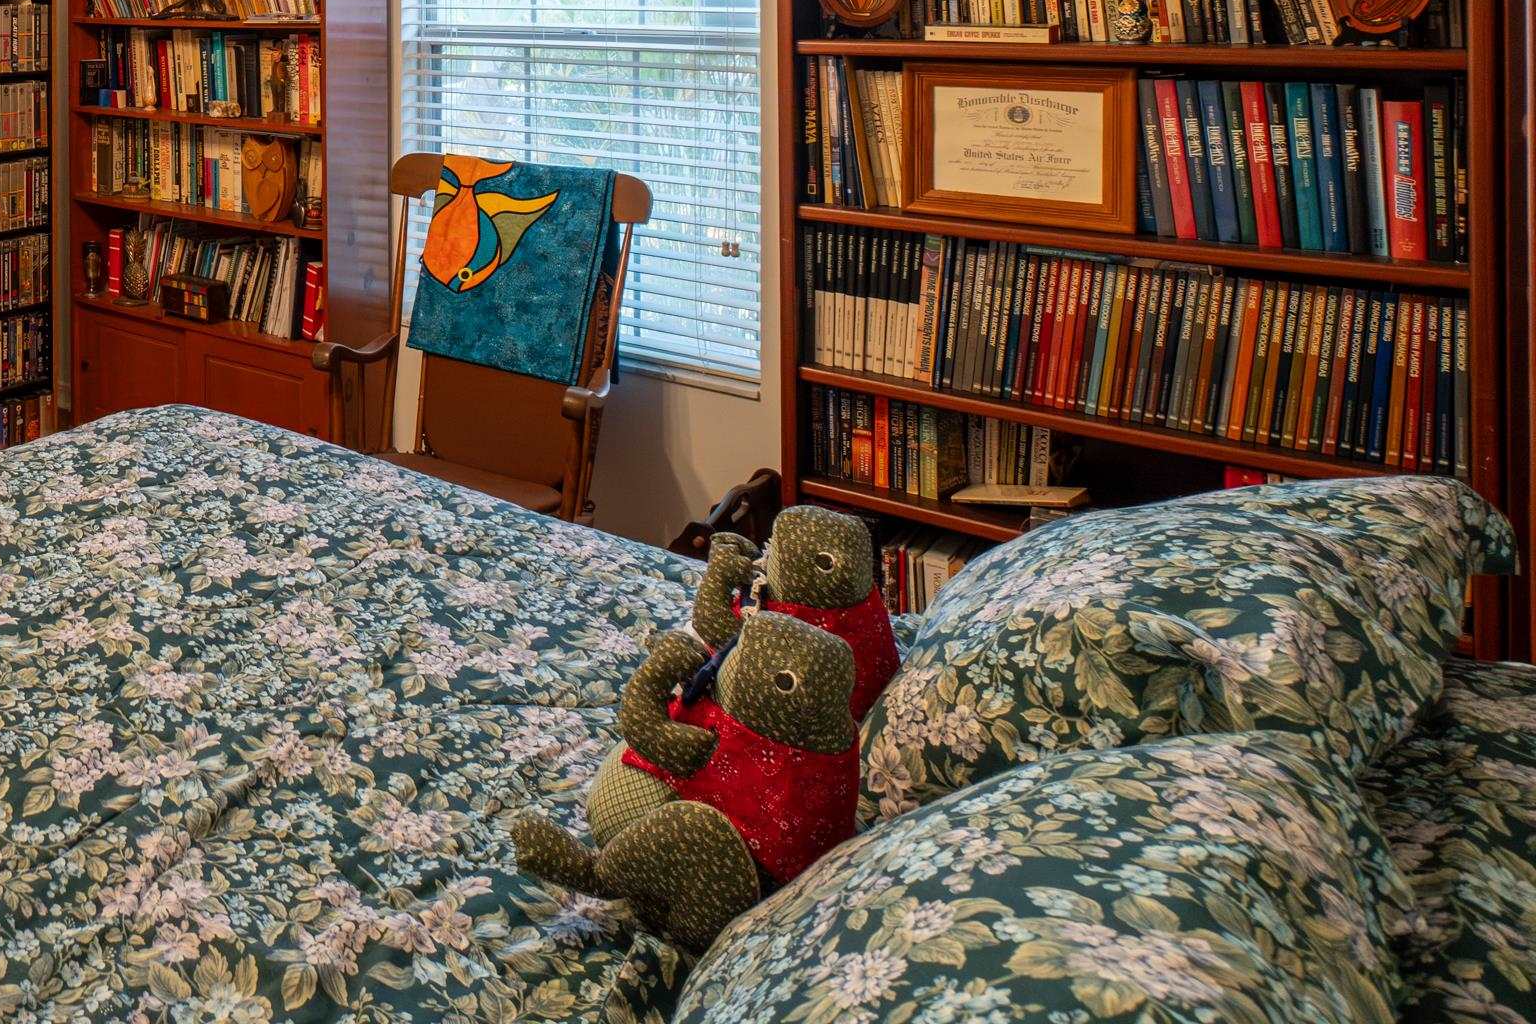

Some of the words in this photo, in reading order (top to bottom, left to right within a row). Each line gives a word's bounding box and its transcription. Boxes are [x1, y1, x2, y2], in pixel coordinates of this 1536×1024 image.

[956, 93, 1017, 109] Honorable
[1019, 92, 1080, 117] Discharge
[805, 109, 817, 144] MAYA
[962, 147, 994, 161] United
[995, 150, 1025, 163] States
[1432, 139, 1445, 157] LINE
[152, 148, 161, 186] COLLAPSE
[1433, 158, 1446, 178] YEAR
[1434, 178, 1446, 196] BOOK
[926, 272, 938, 292] HOME
[1174, 279, 1186, 308] CLEANING
[1186, 280, 1198, 306] PORCHES
[1212, 282, 1224, 300] WALLS
[1210, 301, 1221, 314] AND
[1263, 288, 1276, 310] SPECIAL
[1325, 295, 1338, 323] OUTDOOR
[921, 293, 937, 345] IMPROVEMENTS
[1184, 307, 1194, 319] AND
[1260, 311, 1272, 334] PURPOSE
[1353, 297, 1366, 333] ADVANCED
[1369, 301, 1381, 332] ADVANCED
[1385, 303, 1394, 320] BASIC
[1398, 301, 1410, 331] REPAIRING
[1412, 303, 1423, 333] WORKING
[1428, 305, 1438, 330] ADDING
[1442, 306, 1452, 337] WORKING
[1458, 310, 1468, 319] THE
[1181, 320, 1192, 340] PATIOS
[1206, 314, 1219, 340] CEILINGS
[1382, 320, 1393, 343] WIRING
[1428, 330, 1437, 342] ON
[1457, 320, 1467, 338] HOME
[1256, 335, 1269, 357] ROOMS
[1320, 324, 1334, 359] RECREATION
[1366, 333, 1378, 355] WIRING
[1394, 332, 1407, 367] APPLIANCES
[1410, 334, 1421, 349] WITH
[1441, 337, 1451, 353] WITH
[918, 347, 932, 373] MANUAL
[1348, 333, 1362, 384] WOODWORKING
[1408, 349, 1419, 378] PLASTICS
[1440, 353, 1450, 373] METAL
[1456, 338, 1466, 372] WORKSHOP
[1318, 359, 1329, 378] AREAS
